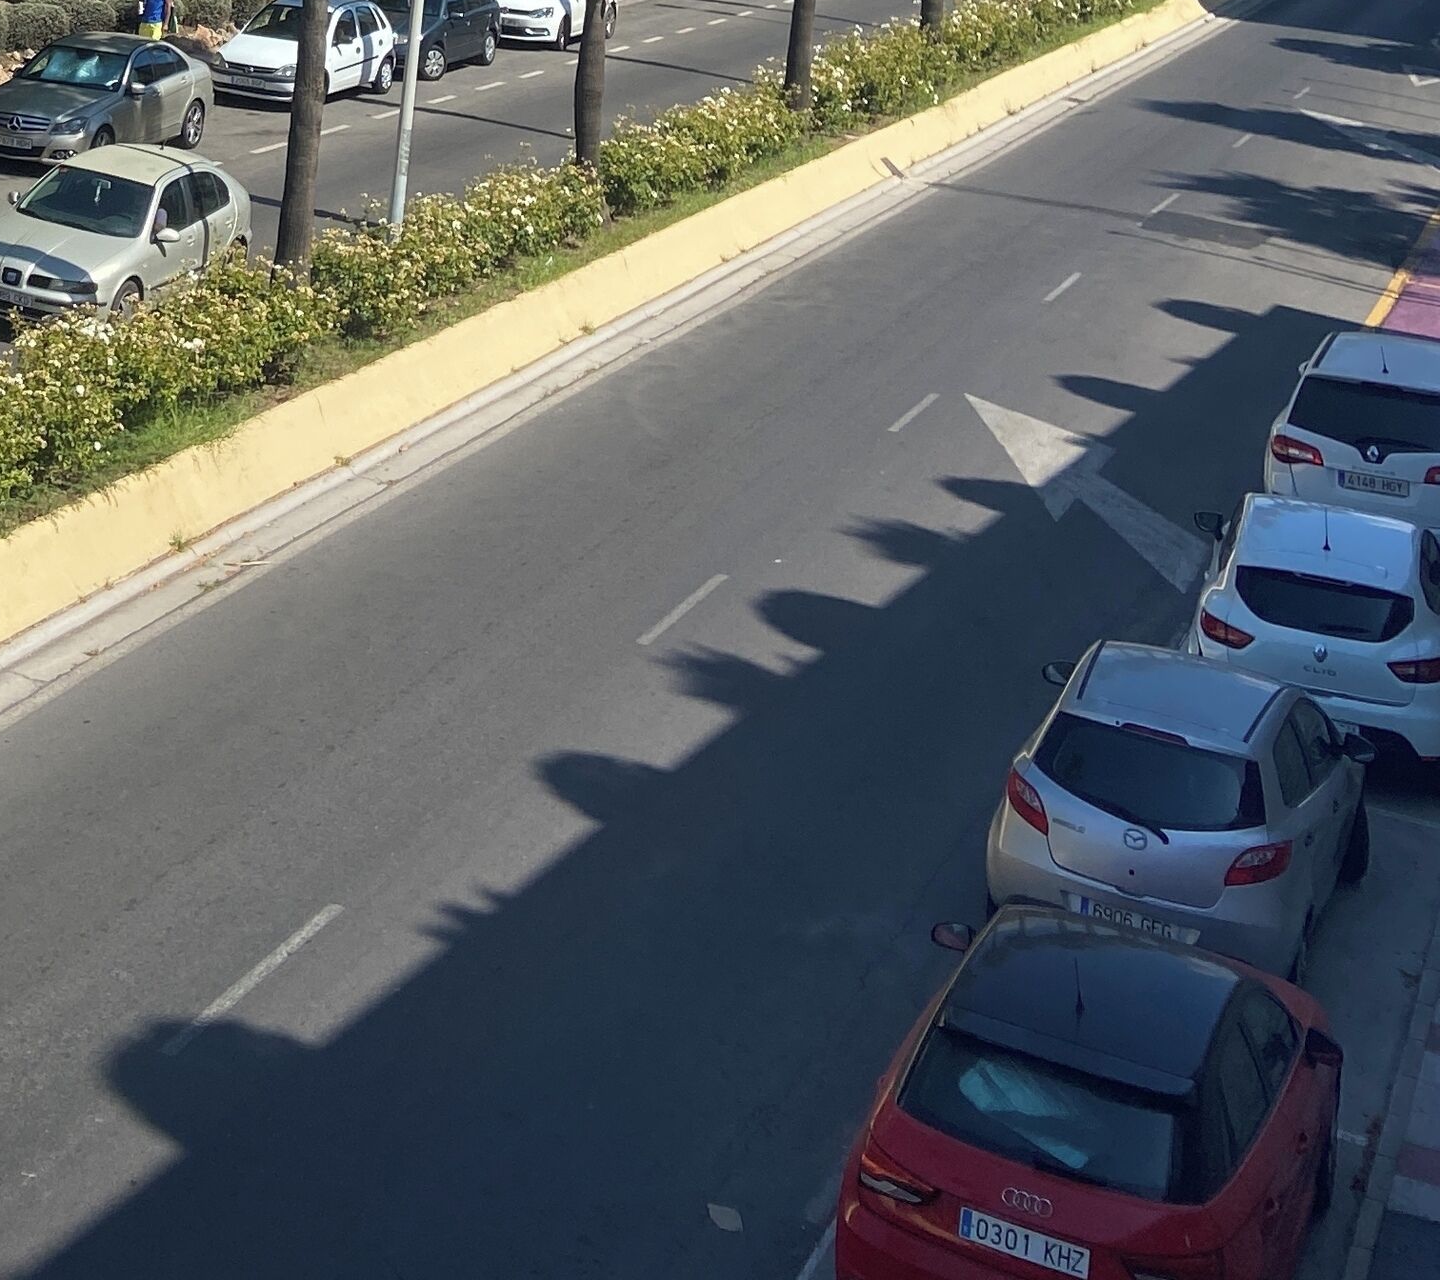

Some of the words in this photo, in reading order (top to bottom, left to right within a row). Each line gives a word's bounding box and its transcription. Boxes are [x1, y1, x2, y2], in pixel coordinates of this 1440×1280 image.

[1348, 474, 1376, 489] 4148
[1382, 479, 1403, 493] HGY
[1303, 665, 1337, 677] CLIO
[976, 1218, 1030, 1257] 0301
[1043, 1240, 1085, 1274] KHZ
